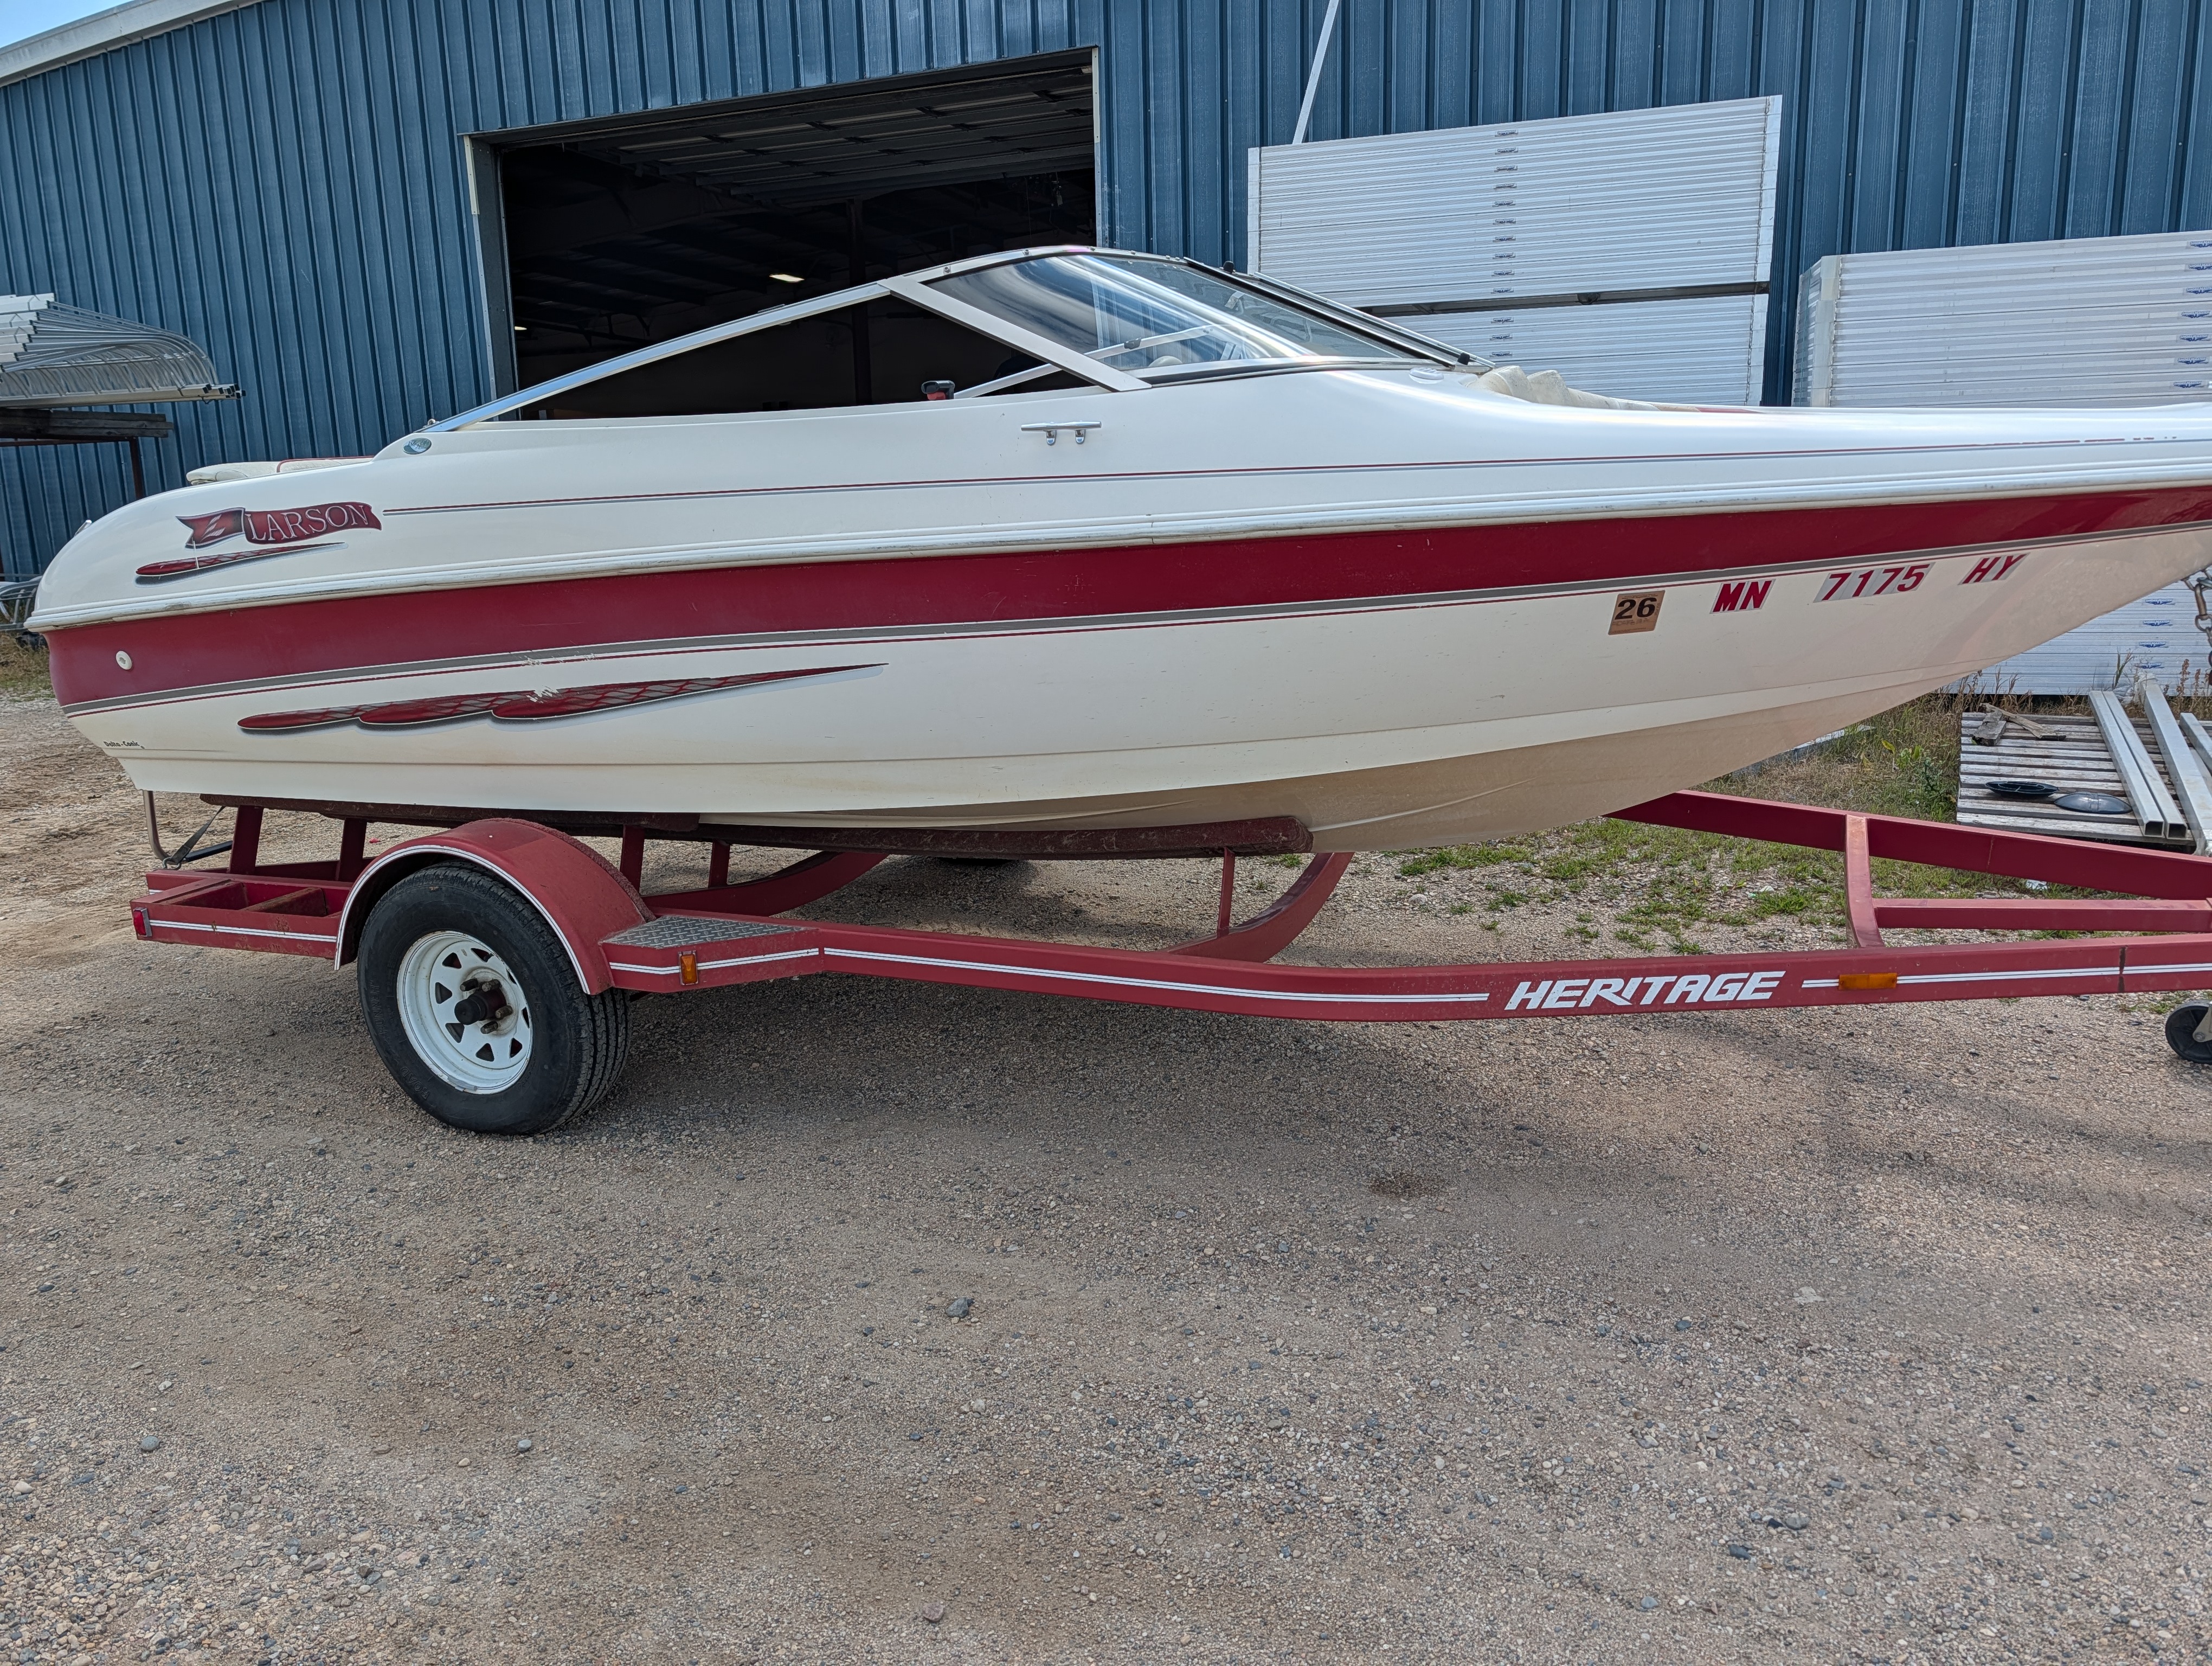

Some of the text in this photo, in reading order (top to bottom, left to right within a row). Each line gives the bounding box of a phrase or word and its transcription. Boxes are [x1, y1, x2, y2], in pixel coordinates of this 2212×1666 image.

[245, 504, 369, 541] LARSON
[1712, 554, 2028, 613] MN 7175 HY
[1615, 597, 1657, 620] 26
[1504, 971, 1786, 1010] HERITAGE
[400, 1067, 431, 1100] ROAD
